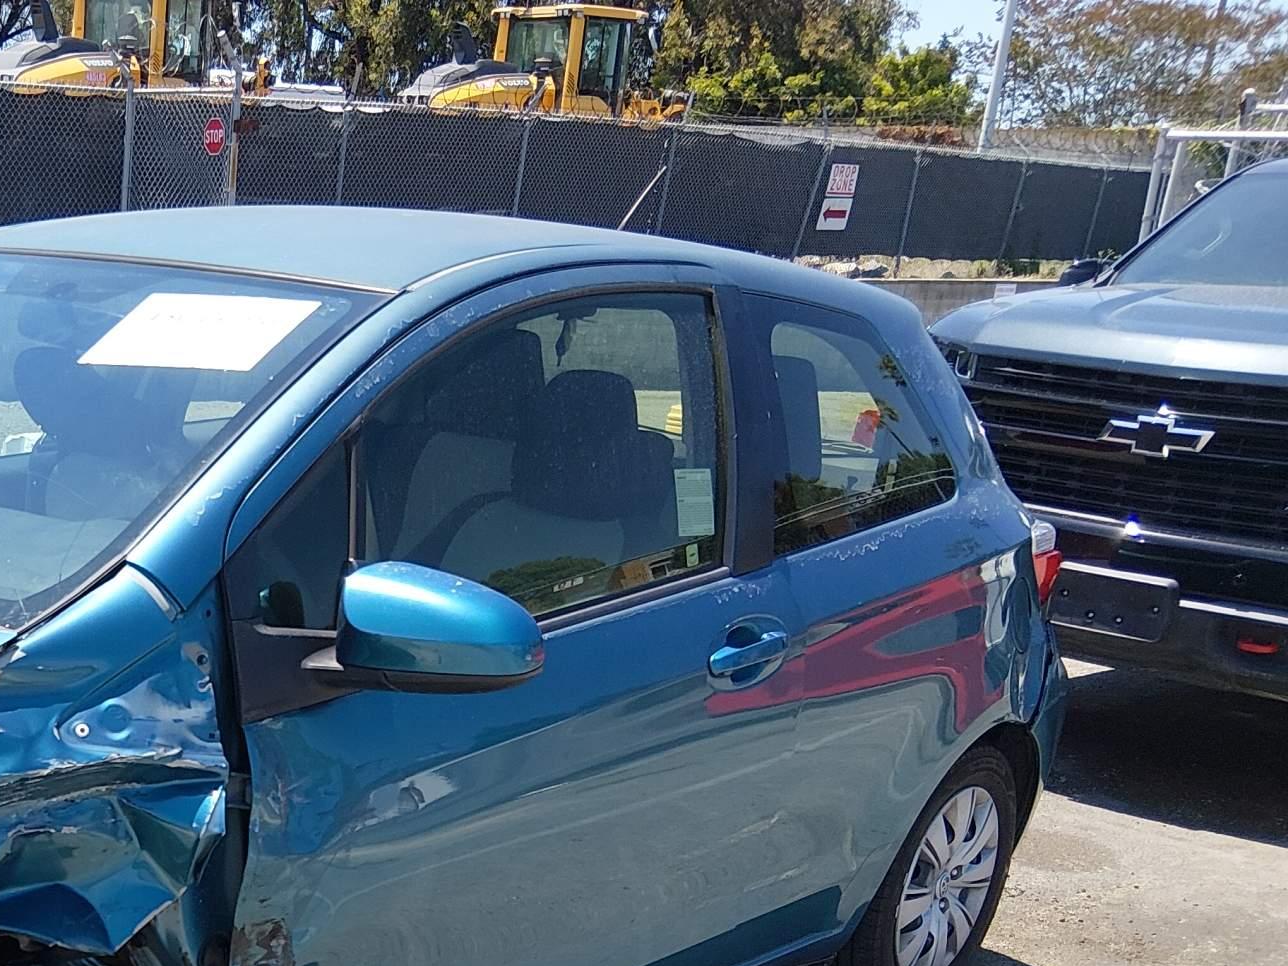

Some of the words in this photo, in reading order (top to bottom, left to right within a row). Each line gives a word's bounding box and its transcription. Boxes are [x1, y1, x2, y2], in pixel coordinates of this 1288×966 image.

[205, 129, 224, 144] STOP
[833, 165, 857, 178] DROP
[830, 178, 854, 191] ZONE
